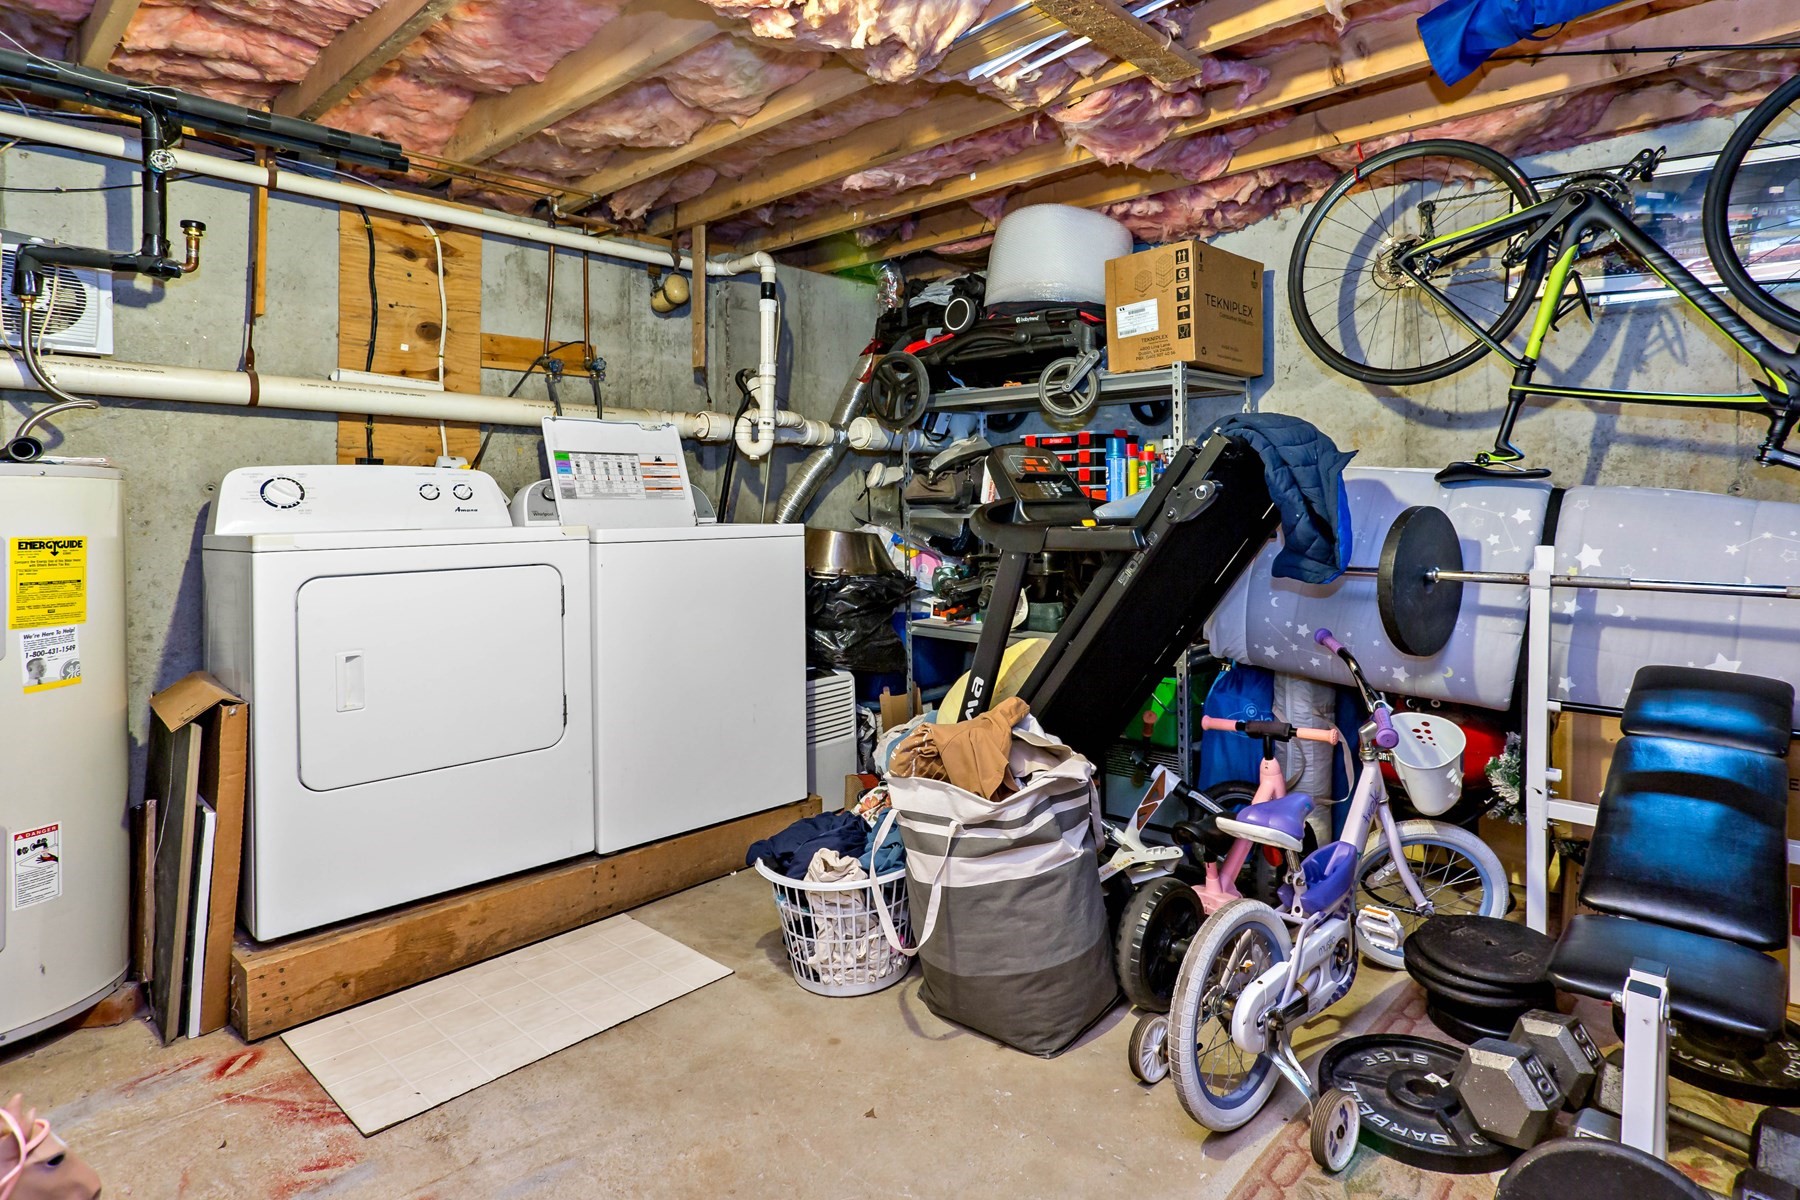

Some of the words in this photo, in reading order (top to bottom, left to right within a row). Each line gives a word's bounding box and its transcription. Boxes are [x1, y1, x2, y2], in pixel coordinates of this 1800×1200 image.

[1204, 293, 1254, 318] TEKNIPLEX
[1141, 334, 1168, 343] TEKNIPLEX
[41, 630, 55, 639] Here
[25, 826, 57, 838] DANGER
[1360, 1051, 1430, 1066] 35LB
[1525, 1060, 1553, 1096] 50
[1341, 1081, 1451, 1146] BARBELL
